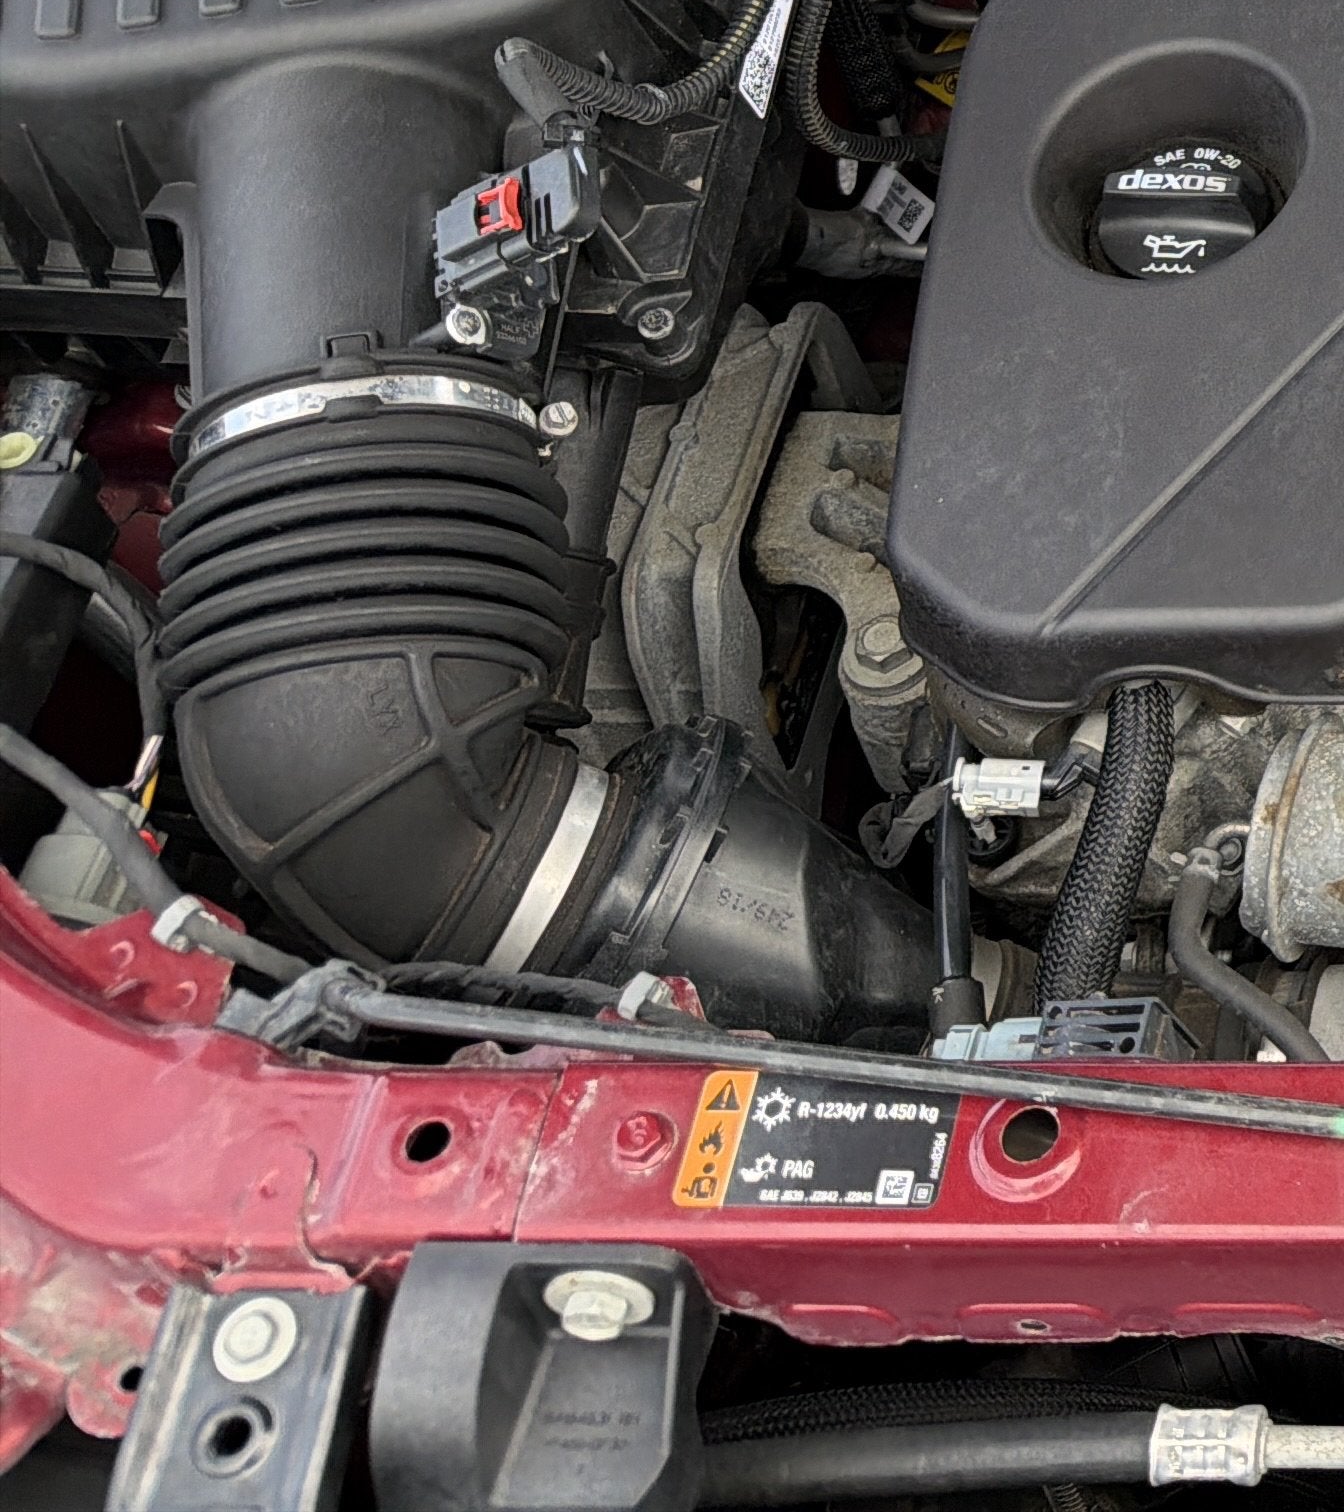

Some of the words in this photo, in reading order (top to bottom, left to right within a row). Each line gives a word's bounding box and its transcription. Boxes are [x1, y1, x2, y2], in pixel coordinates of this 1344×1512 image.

[1154, 149, 1186, 166] SAE
[1194, 148, 1242, 169] 0W-20
[797, 1101, 868, 1123] R-1234yf
[874, 1102, 917, 1121] 0.450
[918, 1103, 939, 1125] kg
[781, 1159, 815, 1180] PAG
[759, 1190, 780, 1202] SAE
